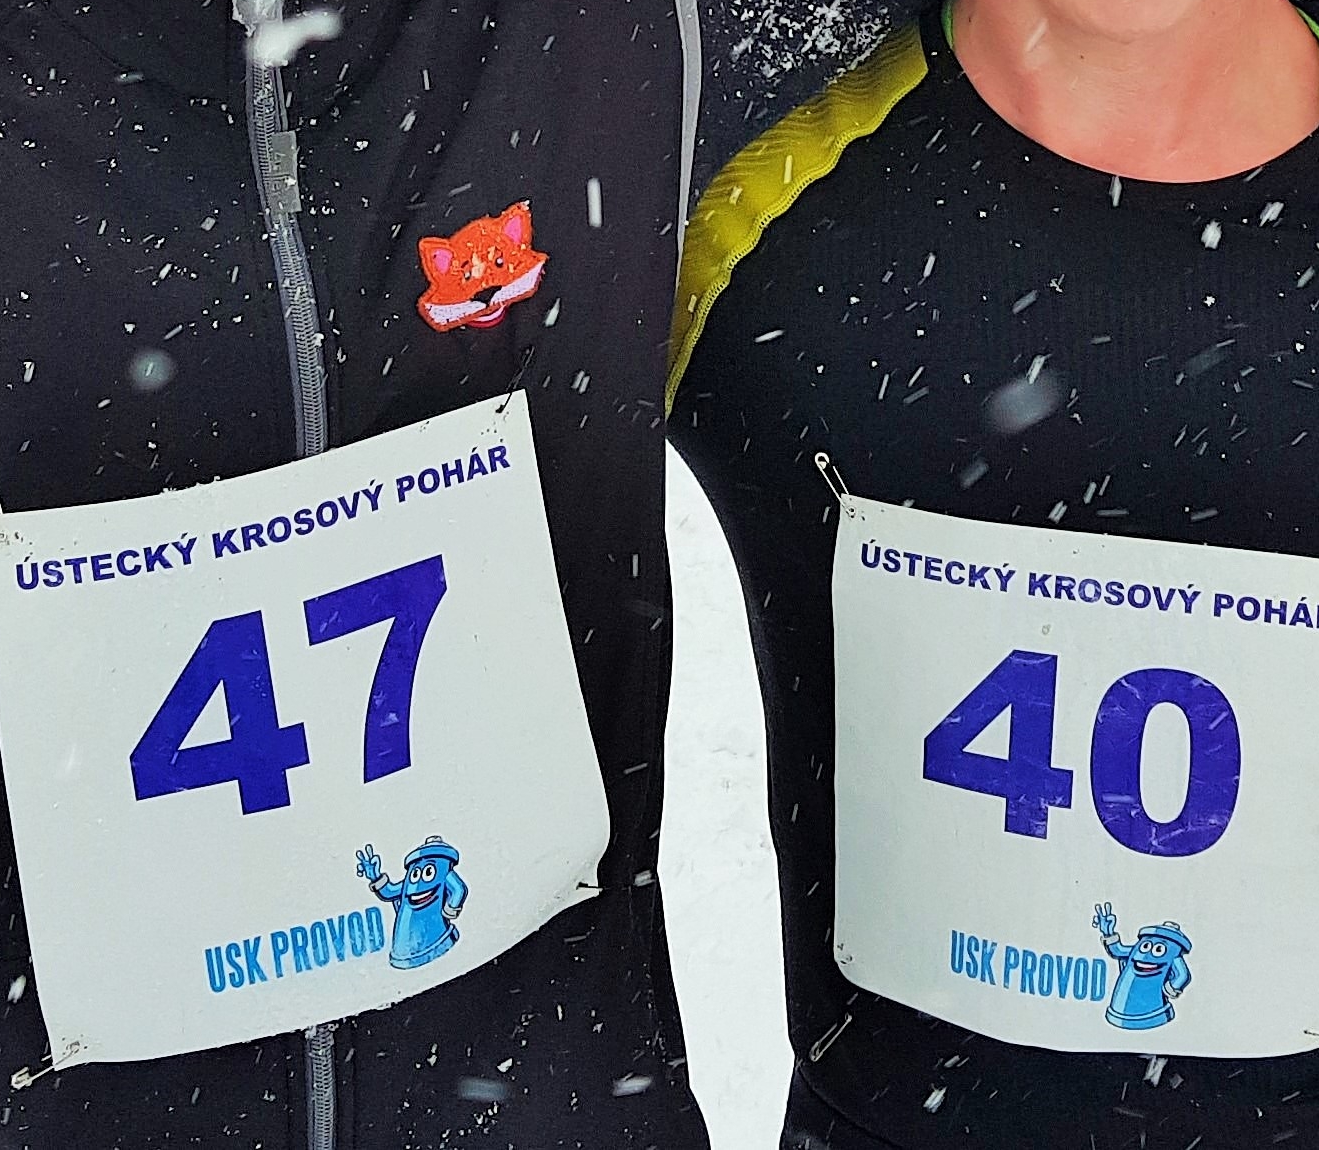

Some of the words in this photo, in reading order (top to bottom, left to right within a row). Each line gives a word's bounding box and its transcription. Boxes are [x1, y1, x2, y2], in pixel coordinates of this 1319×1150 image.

[16, 532, 197, 590] ÚSTECKÝ
[212, 479, 384, 559] KROSOVÝ
[396, 444, 511, 503] POHÁR
[860, 539, 1016, 593] ÚSTECKÝ
[1027, 572, 1201, 615] KROSOVÝ
[130, 553, 448, 815] 47
[923, 649, 1241, 858] 40
[204, 935, 268, 993] USK
[270, 906, 385, 979] PROVOD
[950, 929, 998, 986] USK
[1002, 945, 1107, 1002] PROVOD
